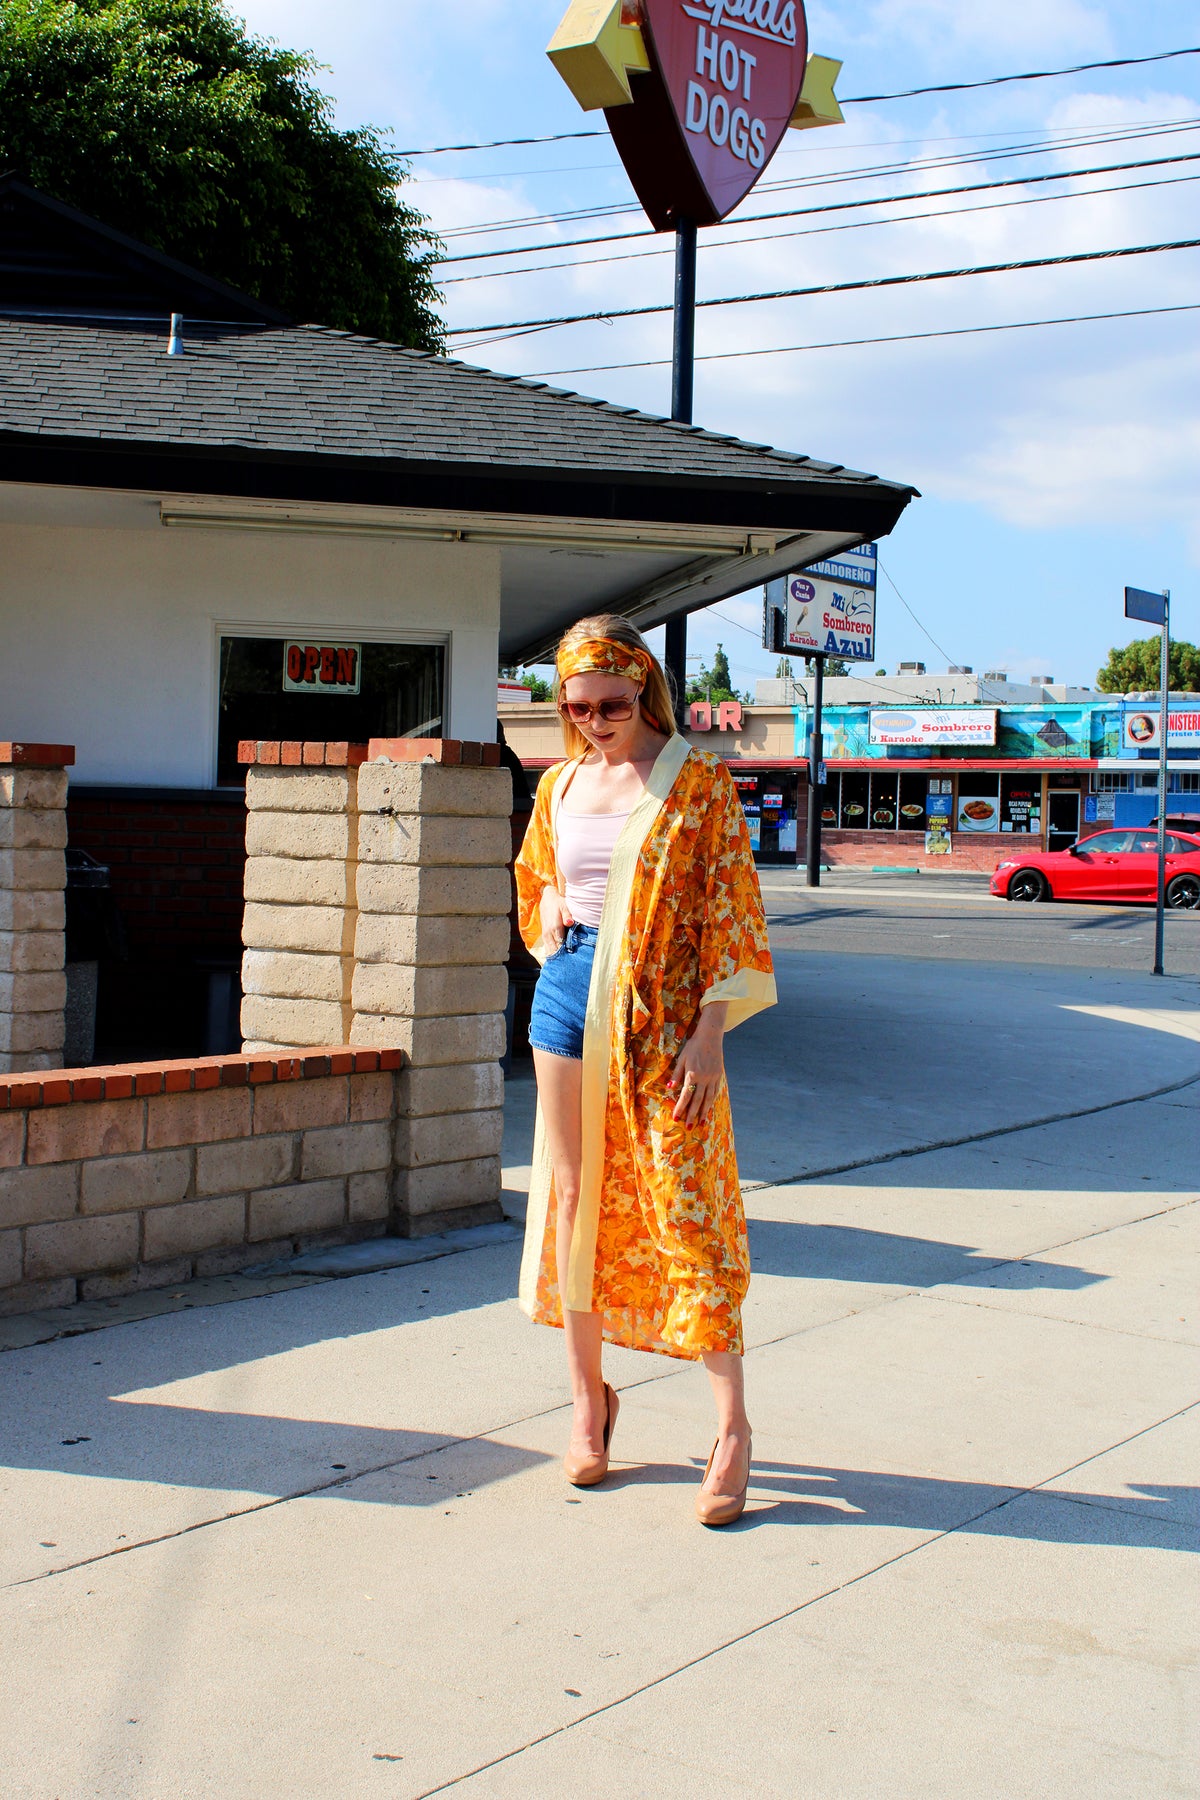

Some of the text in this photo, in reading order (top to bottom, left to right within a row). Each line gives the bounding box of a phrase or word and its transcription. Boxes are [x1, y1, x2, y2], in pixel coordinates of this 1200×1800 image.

[695, 25, 757, 102] HOT
[685, 80, 767, 169] DOGS
[831, 592, 845, 612] Mi
[823, 612, 872, 635] Sombrero
[789, 633, 819, 646] Karaoke
[824, 631, 872, 659] Azul
[287, 645, 357, 686] OPEN
[921, 723, 992, 732] Sombrero
[935, 731, 993, 742] Azul
